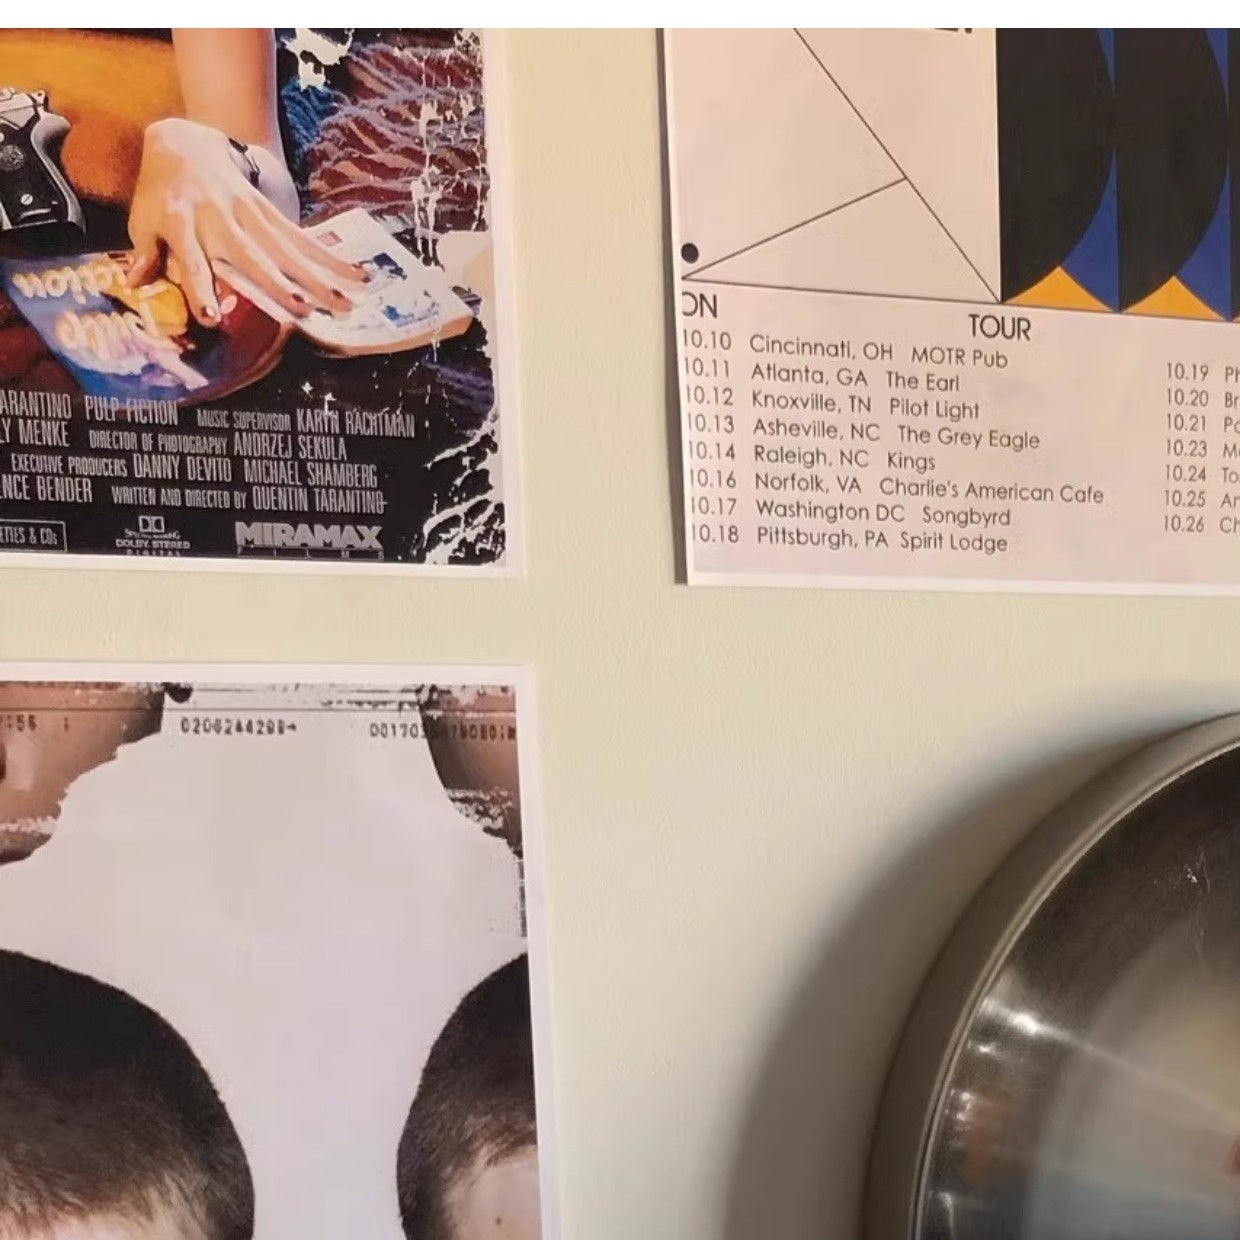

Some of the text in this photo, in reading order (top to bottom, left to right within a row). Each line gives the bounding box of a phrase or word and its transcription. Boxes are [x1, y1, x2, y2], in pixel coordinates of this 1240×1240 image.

[968, 313, 1031, 341] TOUR
[683, 329, 1008, 368] 10.10 Cincinnati, OH MOTR Pub
[685, 357, 960, 392] 10.11 Atlanta, GA The Earl
[1167, 362, 1209, 382] 10.19
[687, 385, 980, 423] 10.12 Knoxville, TN Pilot Light
[1167, 388, 1209, 407] 10.20
[84, 395, 119, 422] PULP
[127, 398, 178, 426] FICTION
[197, 409, 230, 428] MUSIC
[234, 411, 291, 432] SUPERVISOR
[296, 408, 340, 435] KARYN
[346, 411, 415, 438] RACHTMAN
[688, 414, 1040, 452] 10.13 Asheville, NC The Grey Eagle
[1167, 413, 1207, 432] 10.21
[18, 418, 347, 461] MENKE DIRECTOR OF PHOTOGRAPHY ANDRZEJ SEKULA
[1166, 438, 1208, 458] 10.23
[11, 453, 378, 489] EXECUTIVE PRODUCERS DANNY DEVITO MICHAEL SHAMBERG
[689, 441, 936, 474] 10.14 Raleigh, NC Kings
[37, 475, 386, 515] BENDER WRITTEN AND DIRECTED BY QUENTIN TARANTINO
[690, 468, 1104, 504] 10.16 Norfolk, VA Charlie's American Cafe
[691, 496, 1011, 528] 10.17 Washington DC Songbyrd
[235, 521, 384, 549] MIRAMAX
[692, 523, 1008, 555] 10.18 Pittsburgh, PA Spirit Lodge
